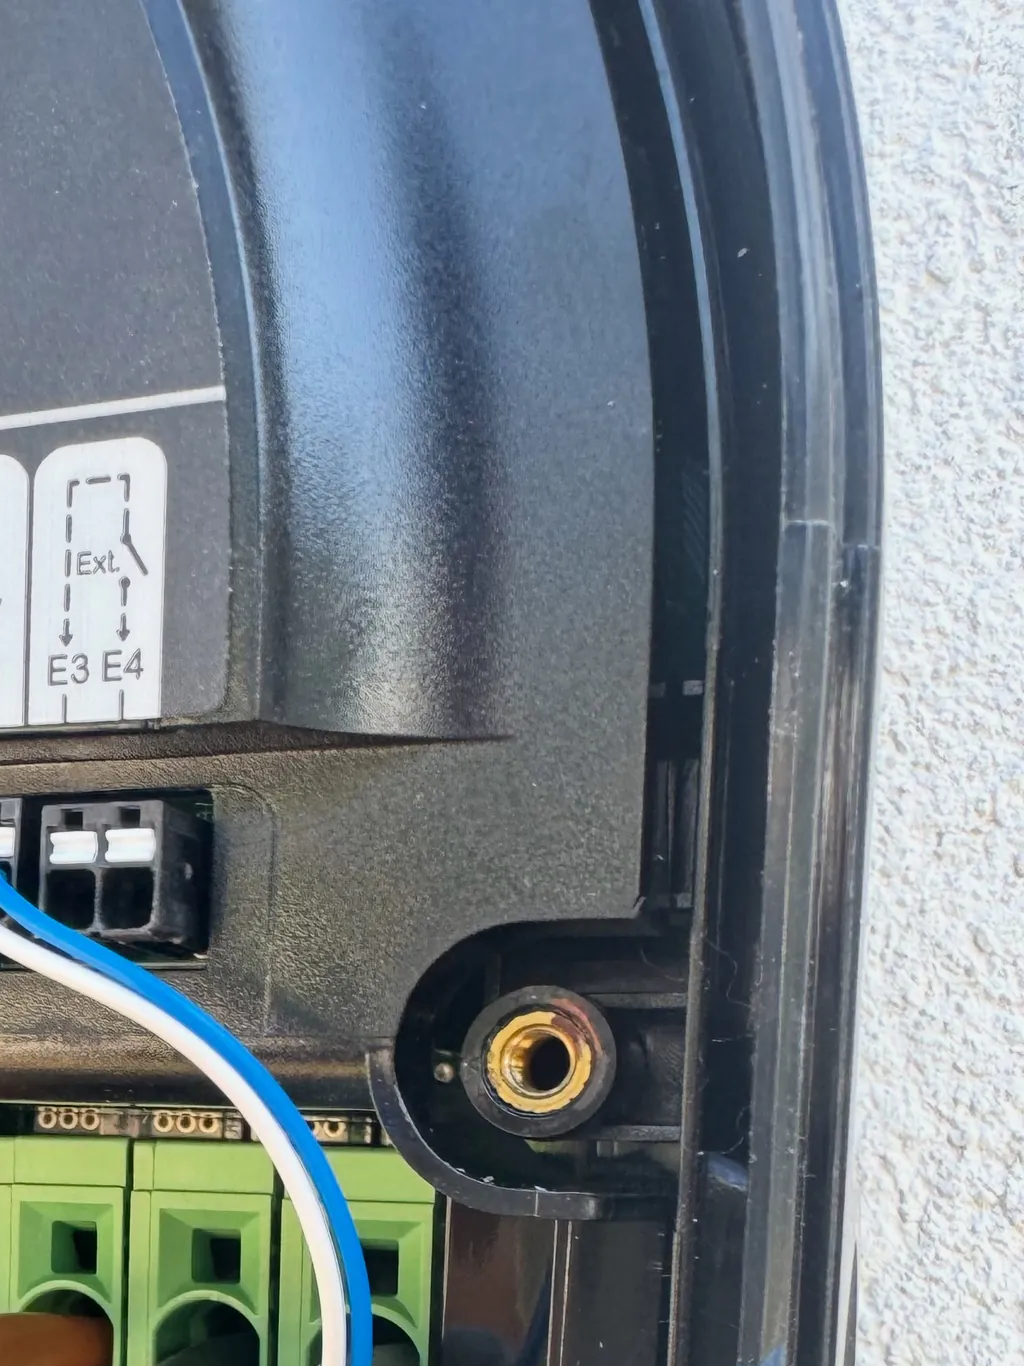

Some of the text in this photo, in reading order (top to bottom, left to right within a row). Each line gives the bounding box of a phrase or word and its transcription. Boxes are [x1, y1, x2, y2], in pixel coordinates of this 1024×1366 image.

[76, 550, 121, 576] Ext.
[48, 649, 144, 686] E3 E4
